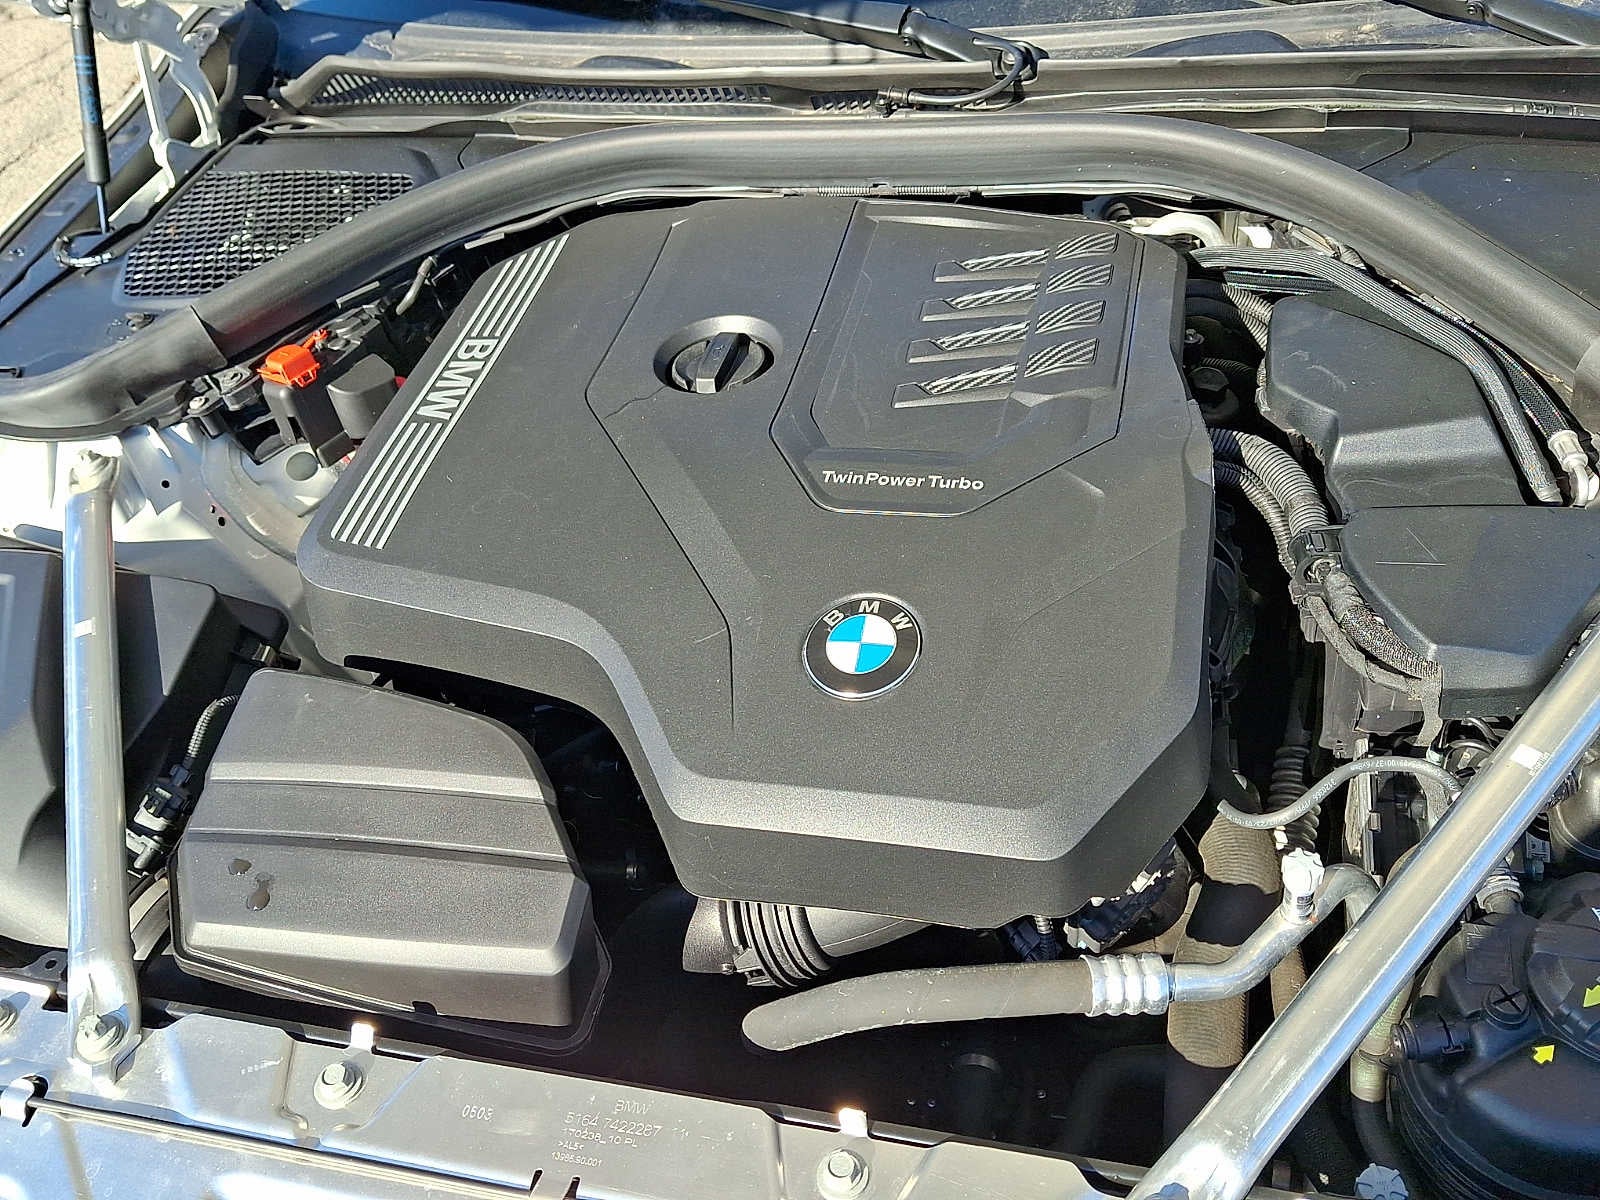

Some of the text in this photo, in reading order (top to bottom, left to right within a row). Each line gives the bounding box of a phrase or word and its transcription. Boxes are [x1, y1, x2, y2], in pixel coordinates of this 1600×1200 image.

[416, 338, 500, 420] BMW
[822, 470, 985, 491] TwinPower Turbo
[822, 600, 914, 632] BMW
[602, 1117, 663, 1138] 7422287
